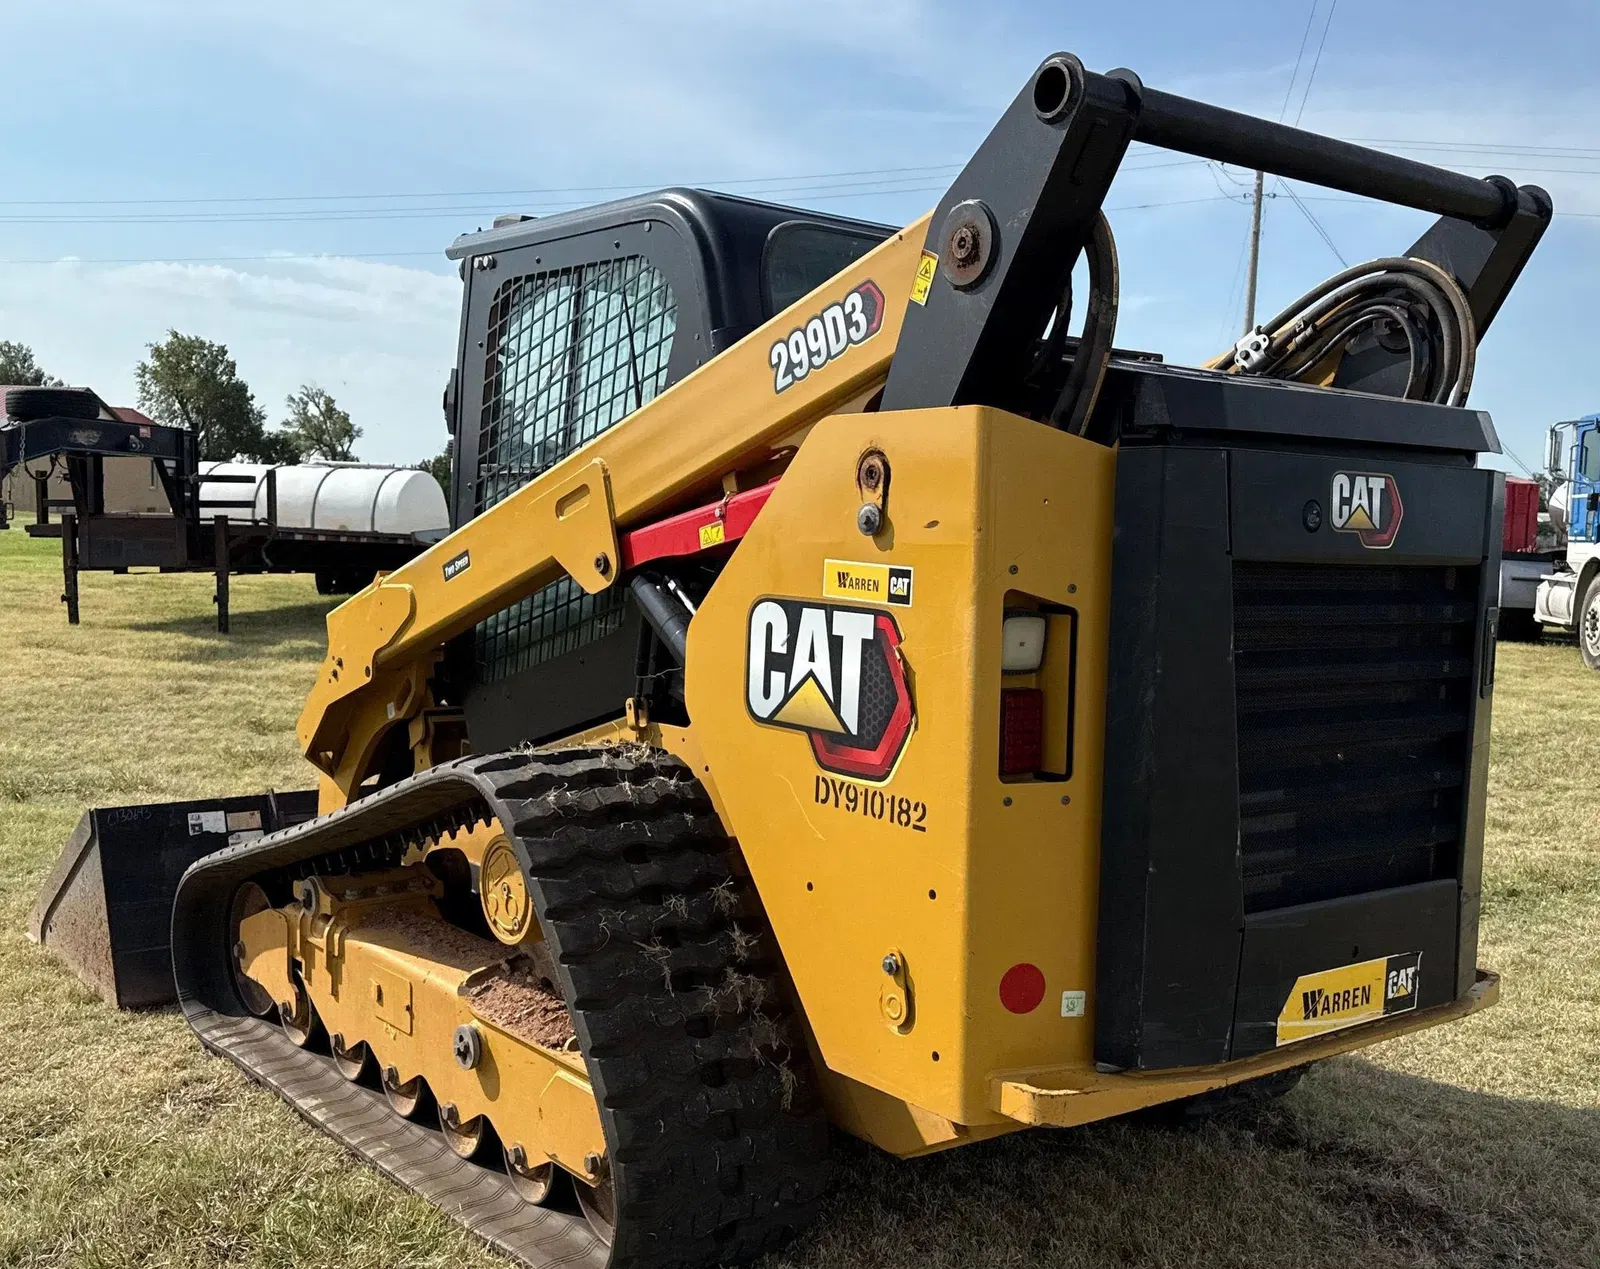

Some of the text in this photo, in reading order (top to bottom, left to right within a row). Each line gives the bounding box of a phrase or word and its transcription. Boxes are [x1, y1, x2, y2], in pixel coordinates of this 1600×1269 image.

[771, 292, 867, 391] 299D3
[1332, 474, 1385, 529] CAT
[837, 571, 910, 596] WARREN CAT
[748, 601, 875, 736] CAT
[814, 775, 928, 833] DY910182
[1302, 966, 1417, 1020] WARREN CAT
